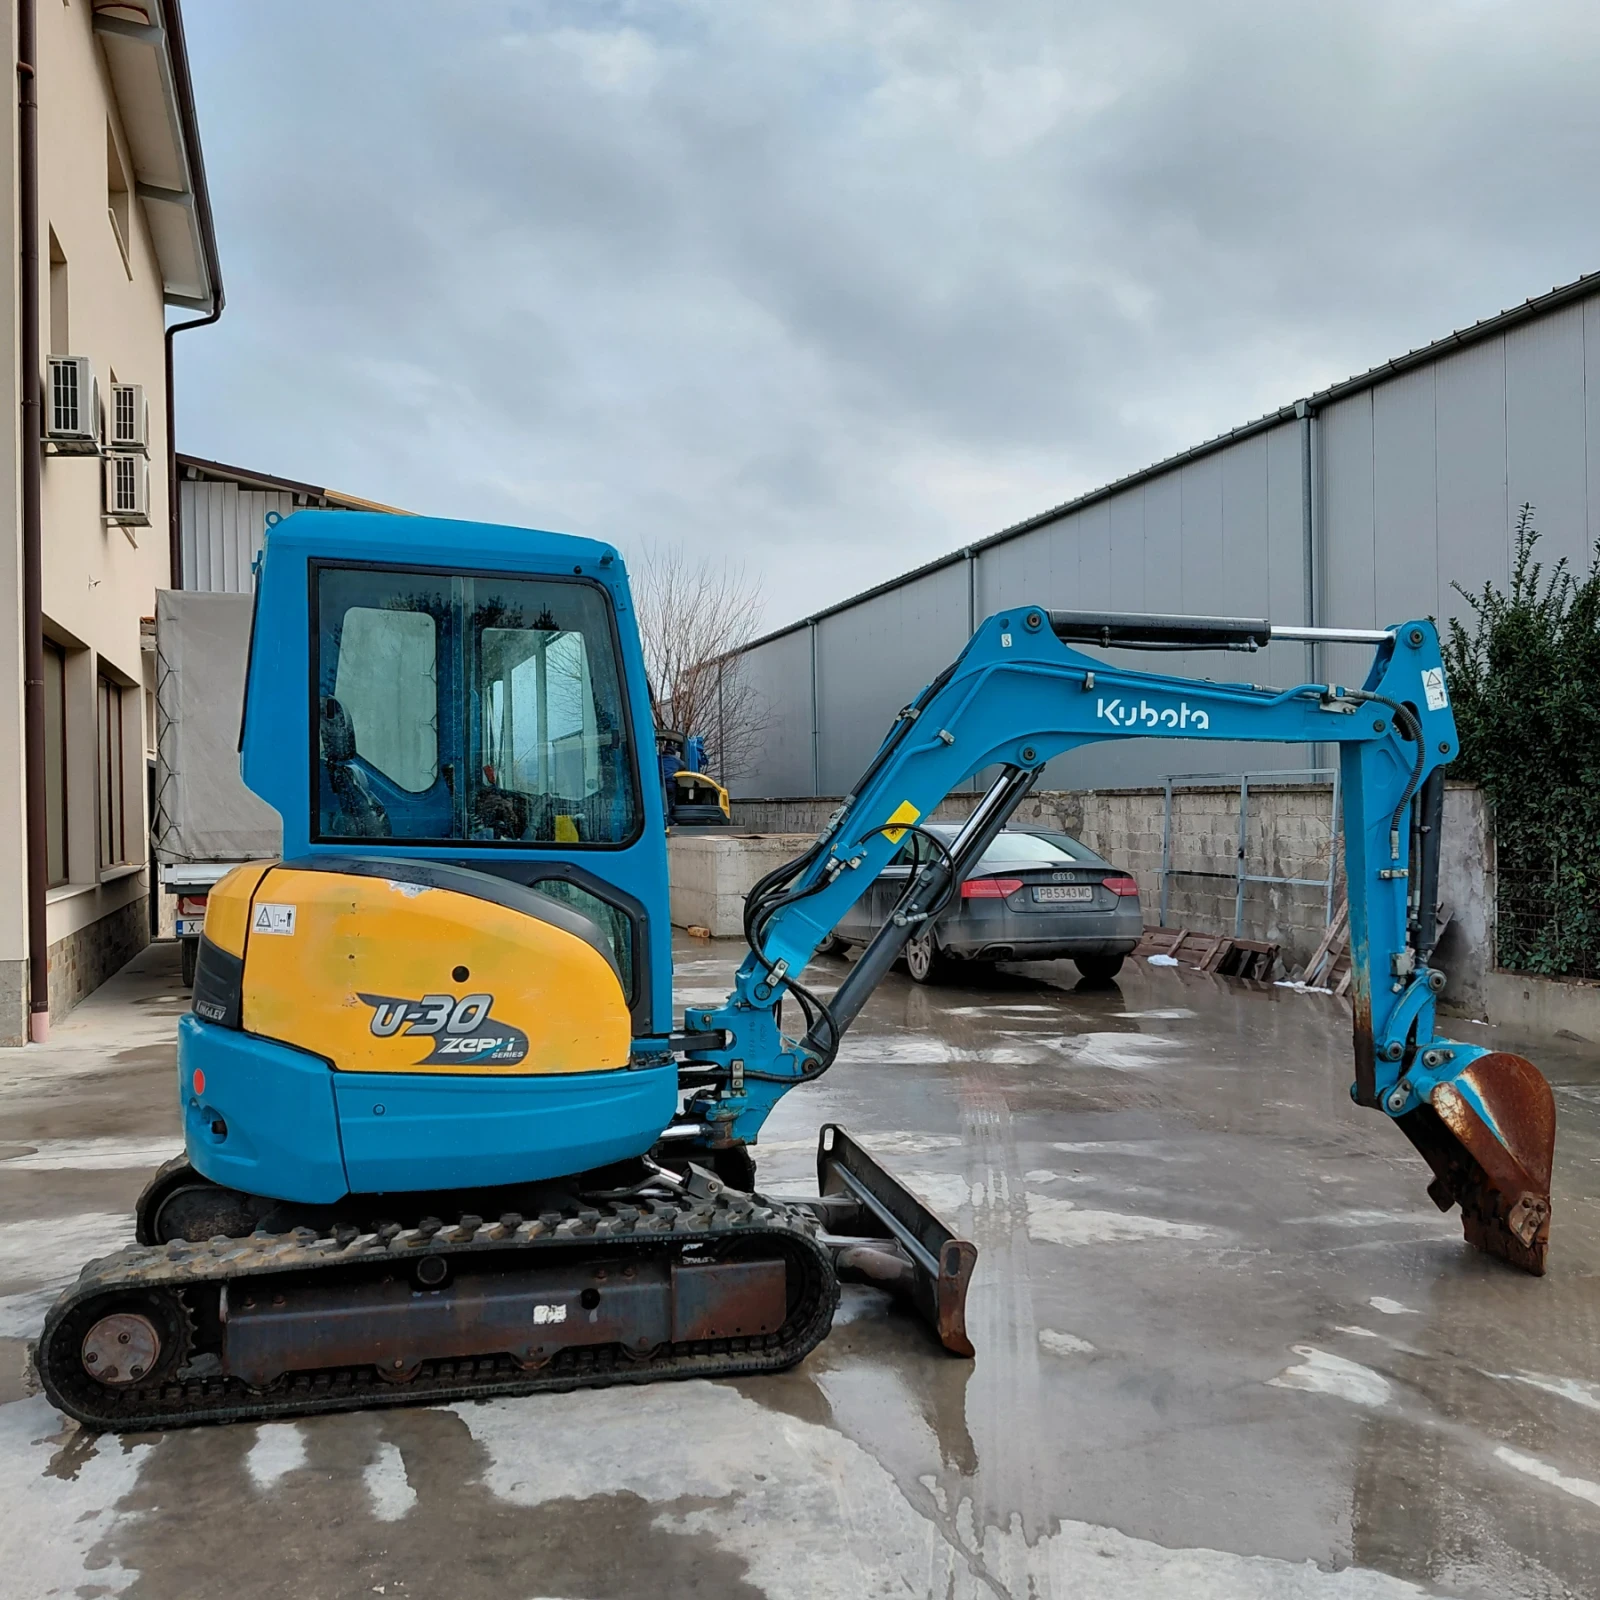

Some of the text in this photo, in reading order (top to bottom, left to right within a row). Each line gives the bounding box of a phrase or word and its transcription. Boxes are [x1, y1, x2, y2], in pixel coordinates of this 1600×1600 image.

[1097, 698, 1209, 729] Kubota
[371, 994, 492, 1036] U-30
[491, 1051, 524, 1059] SERIES
